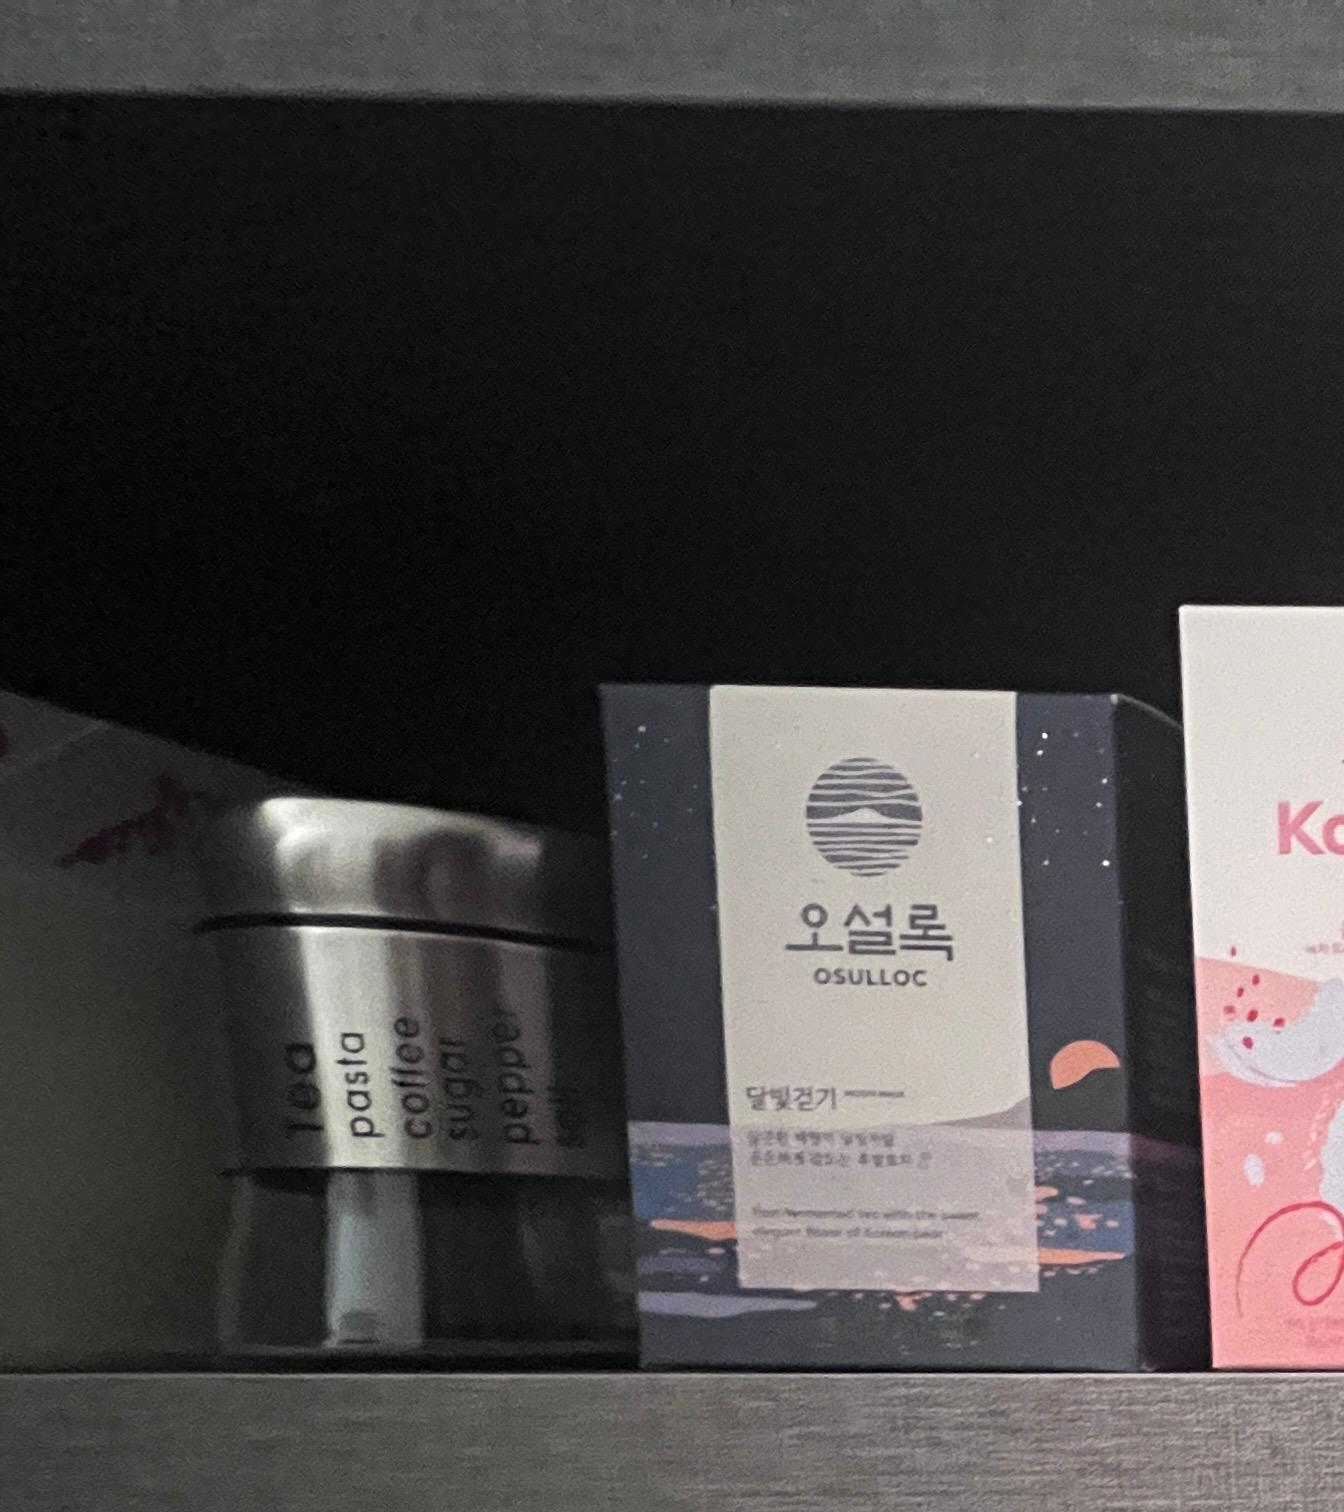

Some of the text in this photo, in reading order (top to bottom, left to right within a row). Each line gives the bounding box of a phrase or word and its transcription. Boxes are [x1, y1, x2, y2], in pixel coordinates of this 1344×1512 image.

[785, 903, 954, 961] 오설록
[813, 967, 928, 987] OSULLOC
[336, 1032, 385, 1140] pasta
[394, 1016, 432, 1141] coffee
[438, 1036, 482, 1141] sugar
